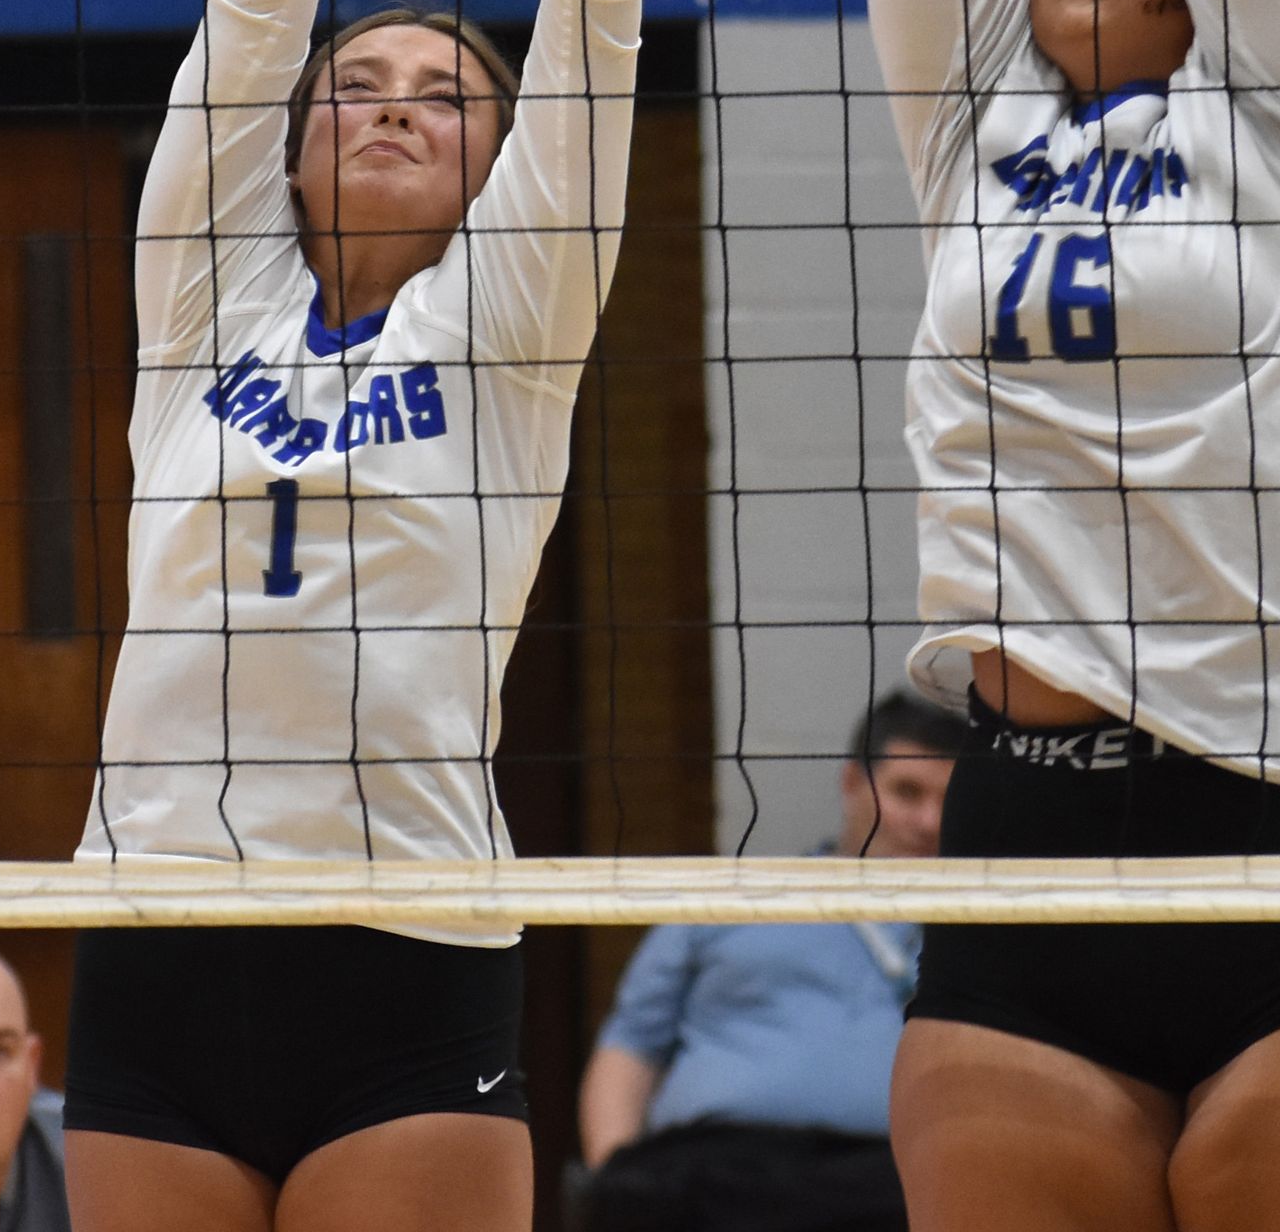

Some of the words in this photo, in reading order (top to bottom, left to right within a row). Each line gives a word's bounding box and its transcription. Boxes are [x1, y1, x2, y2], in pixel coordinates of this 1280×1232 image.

[988, 231, 1117, 362] 16
[202, 347, 447, 467] WARRORS
[262, 477, 303, 598] 1
[990, 725, 1130, 770] NIKE
